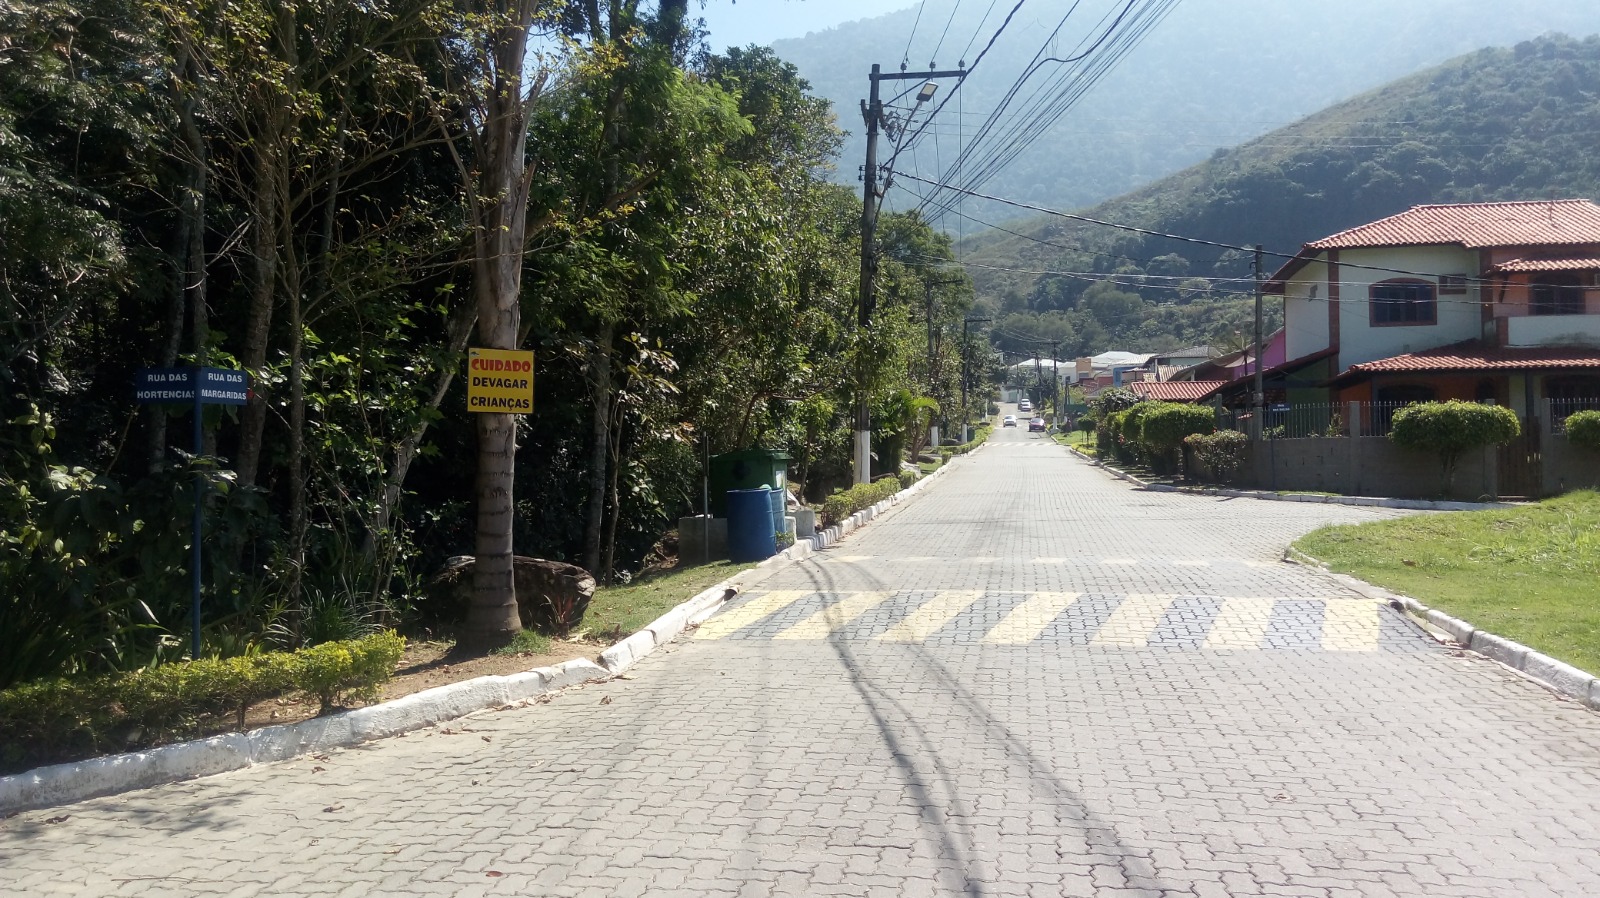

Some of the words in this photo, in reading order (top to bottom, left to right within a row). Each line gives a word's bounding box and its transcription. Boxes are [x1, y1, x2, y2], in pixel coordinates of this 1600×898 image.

[471, 358, 531, 373] CUIDADO
[147, 374, 166, 382] RUA
[168, 373, 188, 381] DAS
[207, 372, 225, 381] RUA
[226, 374, 243, 383] DAS
[472, 376, 528, 389] DEVAGAR
[201, 388, 247, 400] MARGARIDAS
[470, 396, 530, 411] CRIANÇAS
